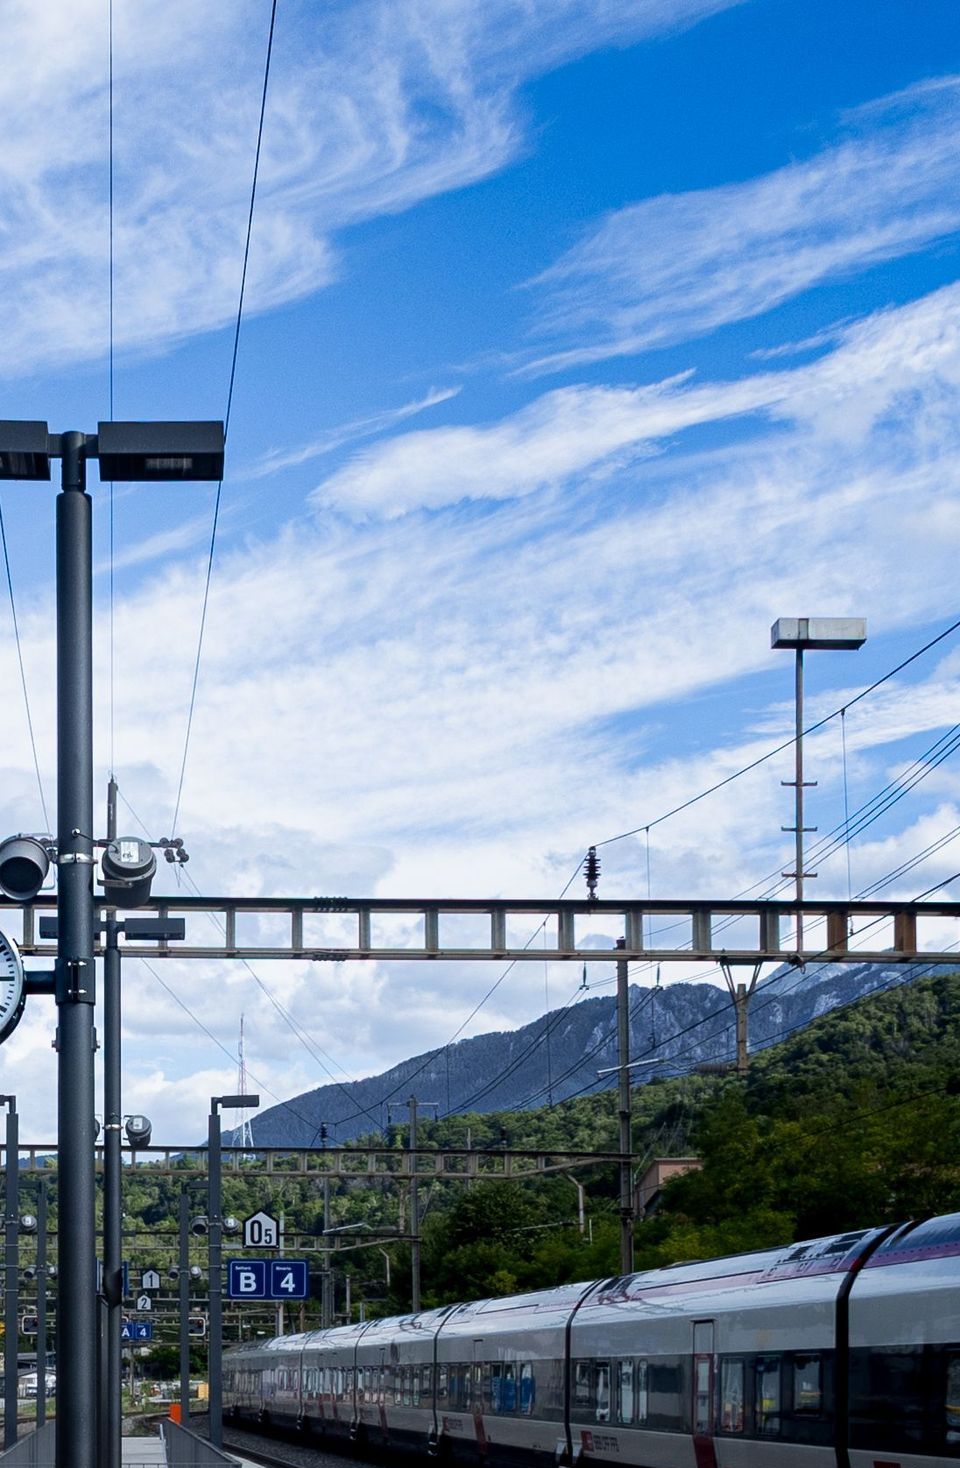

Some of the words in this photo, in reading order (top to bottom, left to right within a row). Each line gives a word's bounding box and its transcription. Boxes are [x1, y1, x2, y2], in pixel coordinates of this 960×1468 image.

[148, 1273, 154, 1287] 1
[239, 1272, 257, 1292] B
[280, 1272, 296, 1293] 4
[141, 1298, 147, 1308] 2
[122, 1328, 130, 1336] A
[140, 1328, 147, 1336] 4
